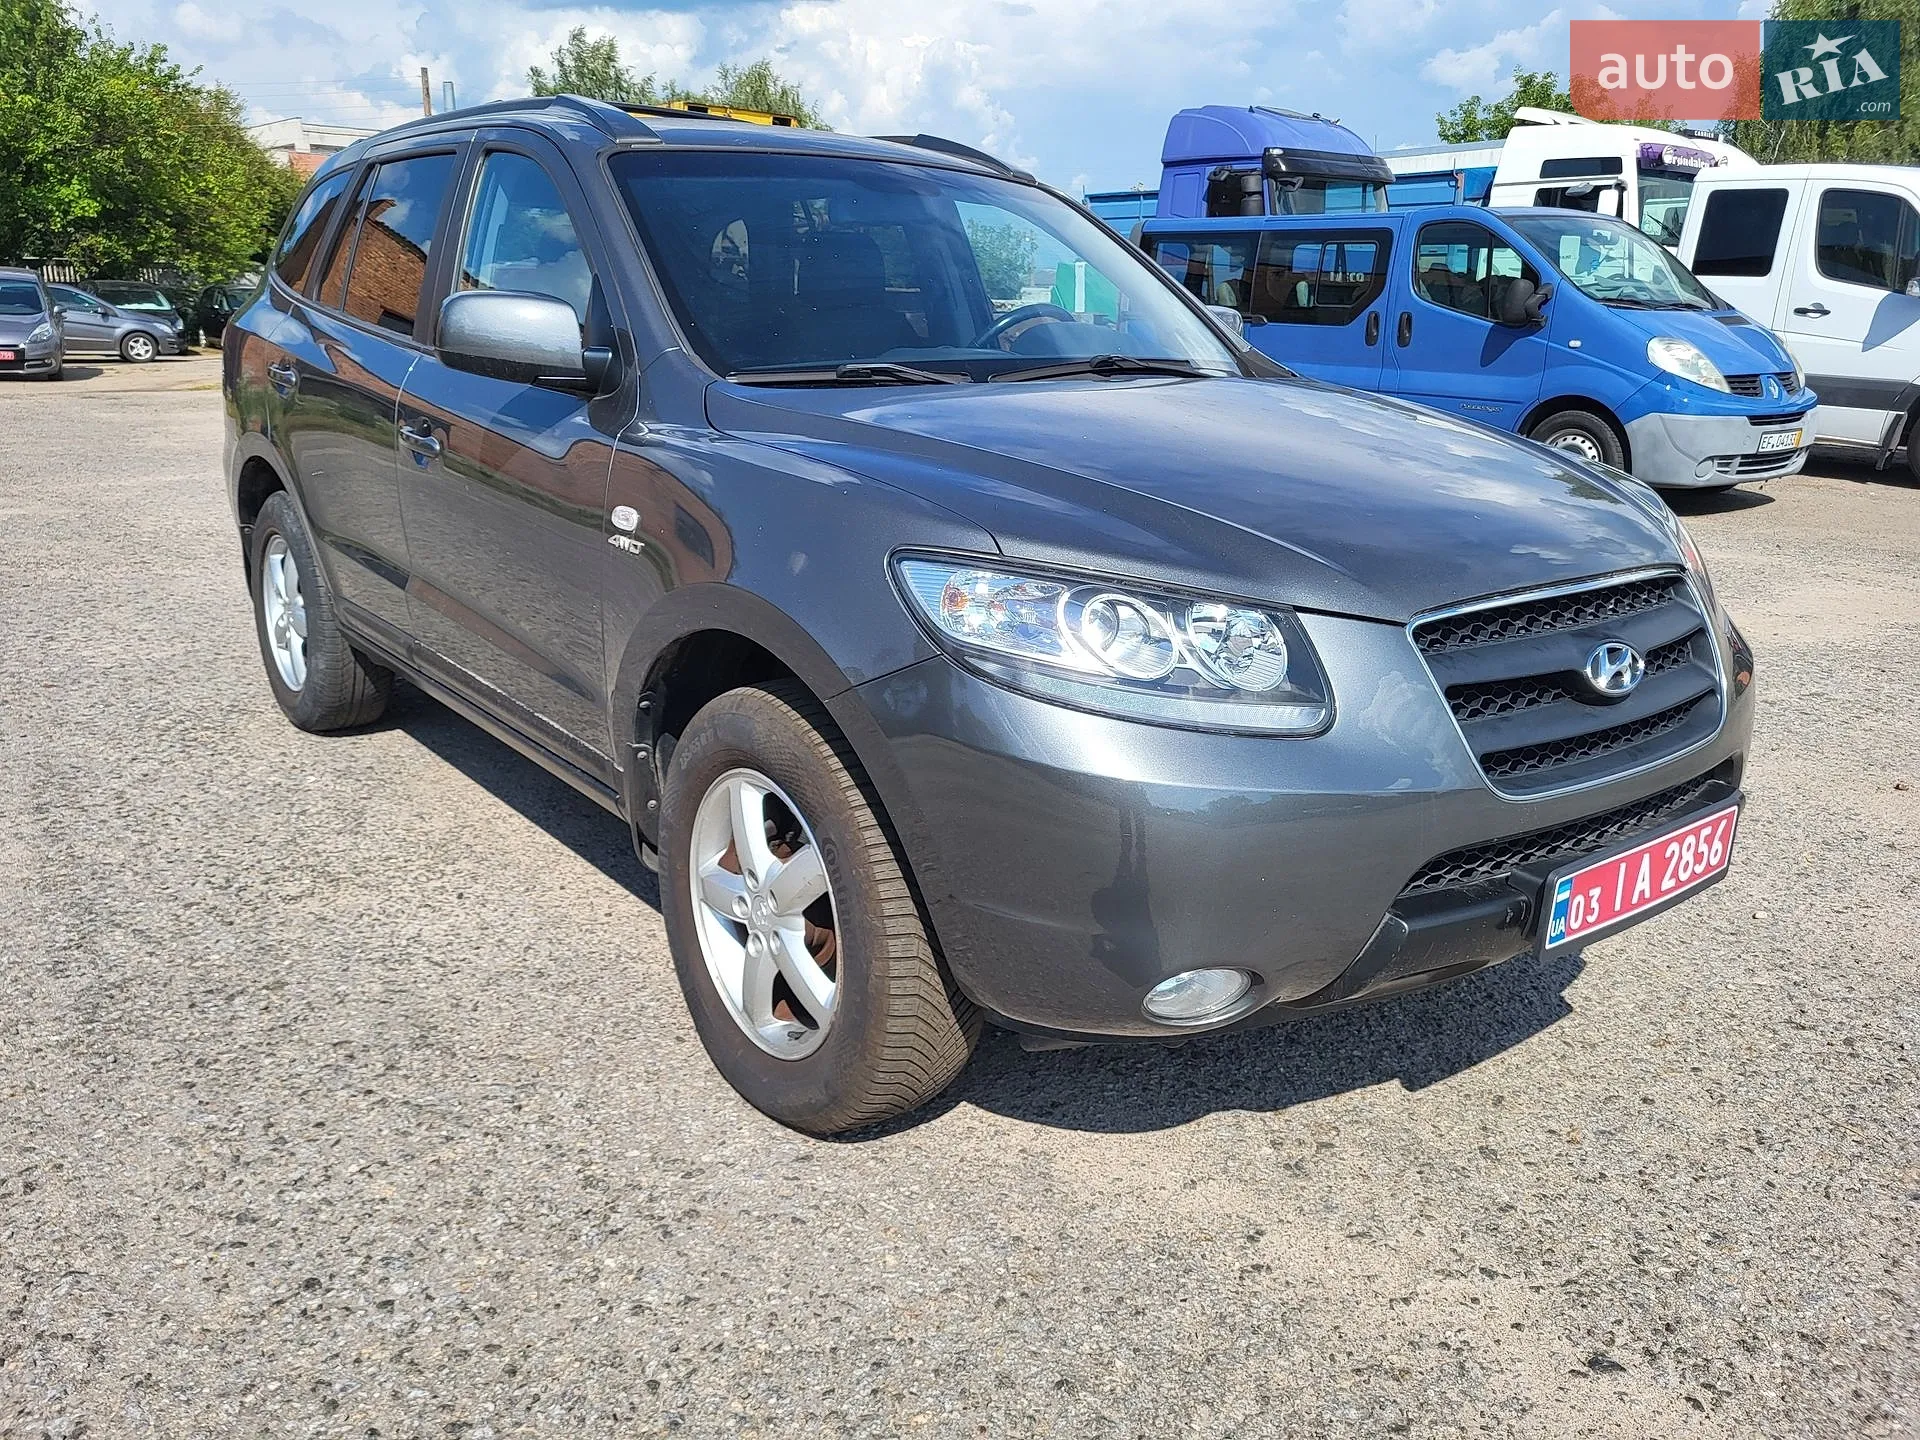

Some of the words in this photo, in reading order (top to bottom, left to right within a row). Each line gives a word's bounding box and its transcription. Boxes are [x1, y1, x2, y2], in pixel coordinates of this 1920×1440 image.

[1569, 886, 1601, 930] 03
[1613, 853, 1651, 912] IA
[1660, 818, 1728, 892] 2856
[1550, 916, 1565, 937] UA
